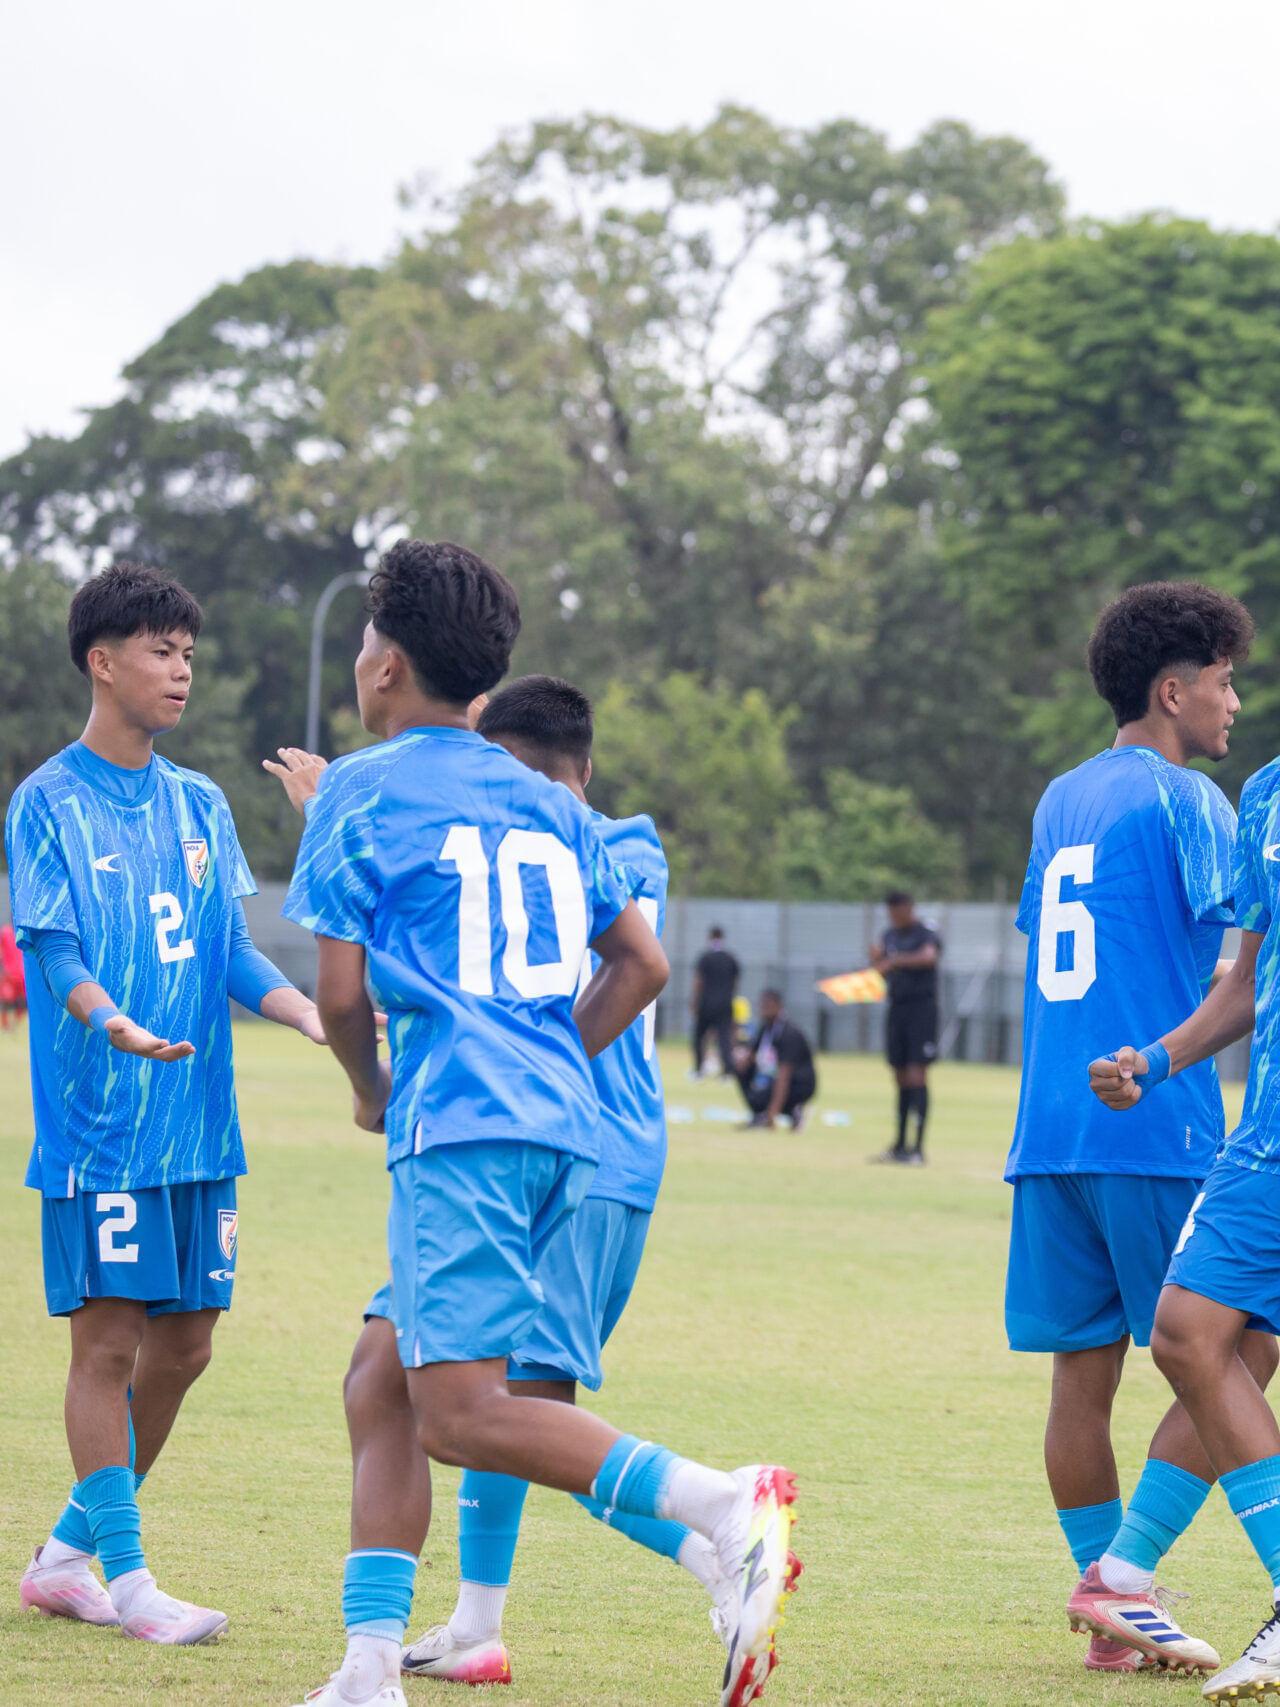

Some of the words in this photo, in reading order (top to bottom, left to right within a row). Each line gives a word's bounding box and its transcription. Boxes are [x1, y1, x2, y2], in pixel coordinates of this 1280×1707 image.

[149, 892, 196, 964] 2
[439, 826, 589, 998] 10
[1037, 843, 1097, 1002] 6
[97, 1193, 139, 1263] 2
